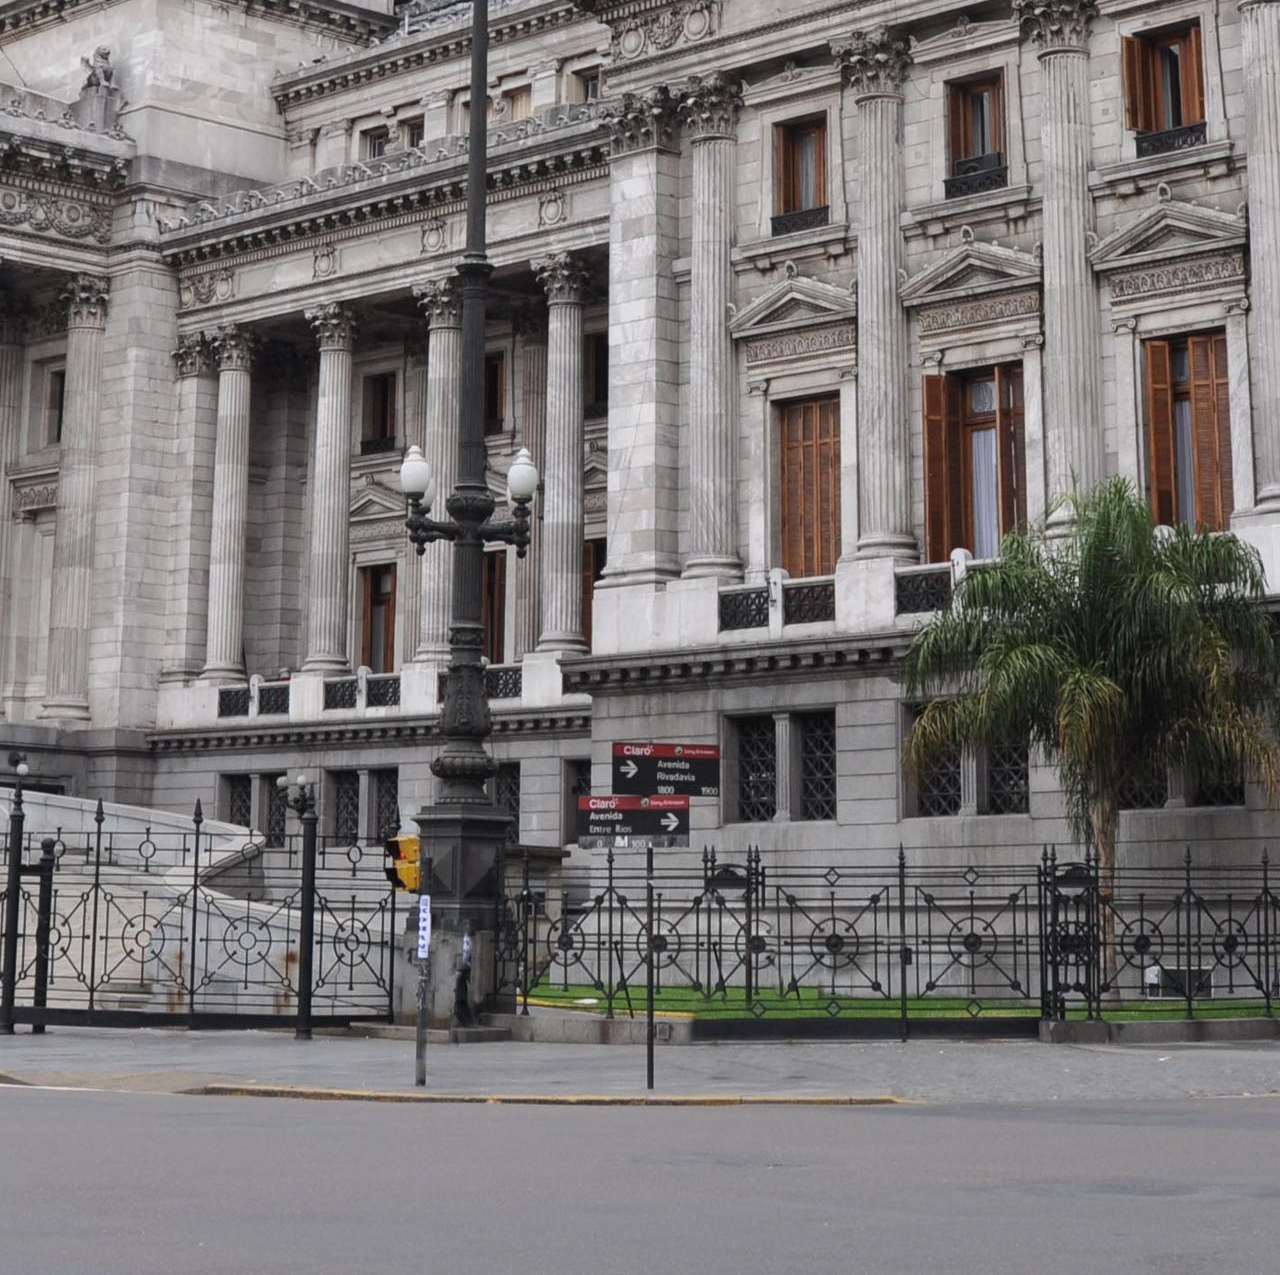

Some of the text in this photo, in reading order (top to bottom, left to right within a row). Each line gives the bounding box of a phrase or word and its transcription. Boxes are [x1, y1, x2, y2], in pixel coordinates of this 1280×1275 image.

[623, 745, 651, 756] Claro
[657, 760, 690, 770] Avenida
[657, 772, 696, 782] Rivadavia
[657, 786, 718, 795] 1800 1900
[589, 798, 616, 809] Claro
[589, 812, 623, 821] Avenida
[589, 825, 612, 834] Entre
